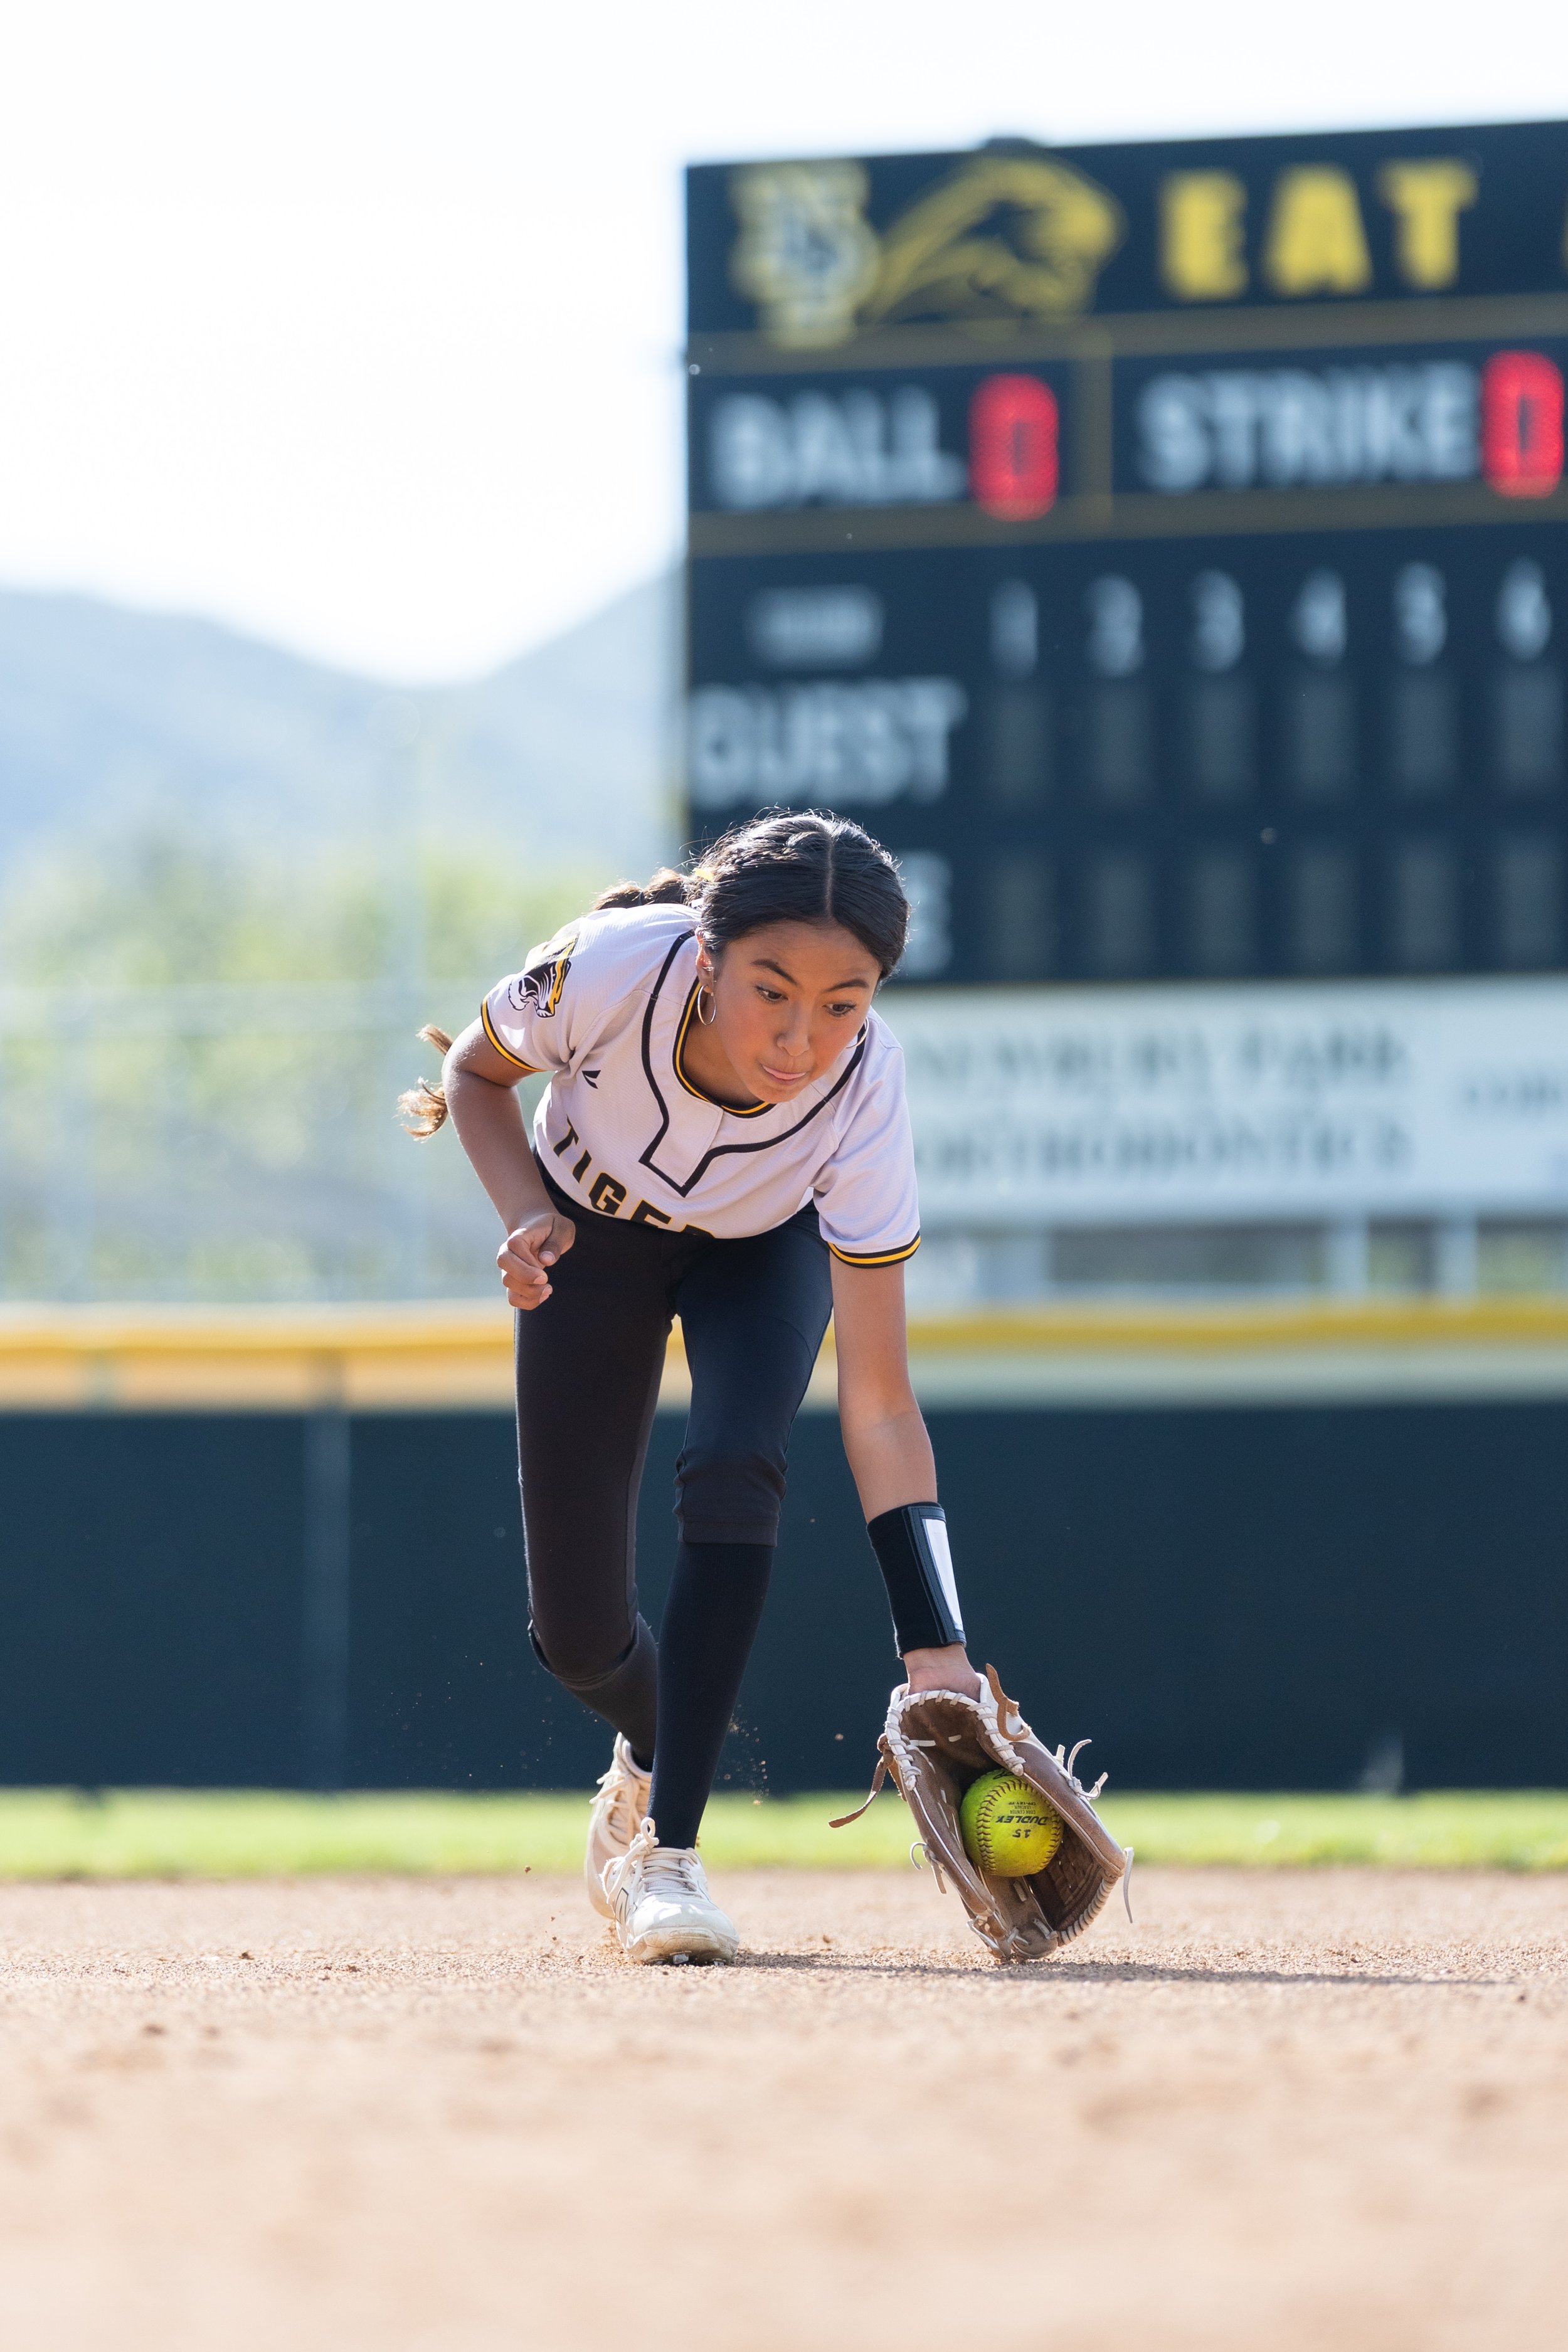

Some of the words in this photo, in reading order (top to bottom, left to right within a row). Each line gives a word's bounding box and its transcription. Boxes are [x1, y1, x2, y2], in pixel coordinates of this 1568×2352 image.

[1160, 157, 1475, 301] EAT
[710, 392, 966, 507] BALL
[968, 374, 1059, 521] 0
[1140, 367, 1479, 492] STRIKE
[553, 1114, 715, 1239] TIGE
[995, 1815, 1049, 1825] DUDLEY
